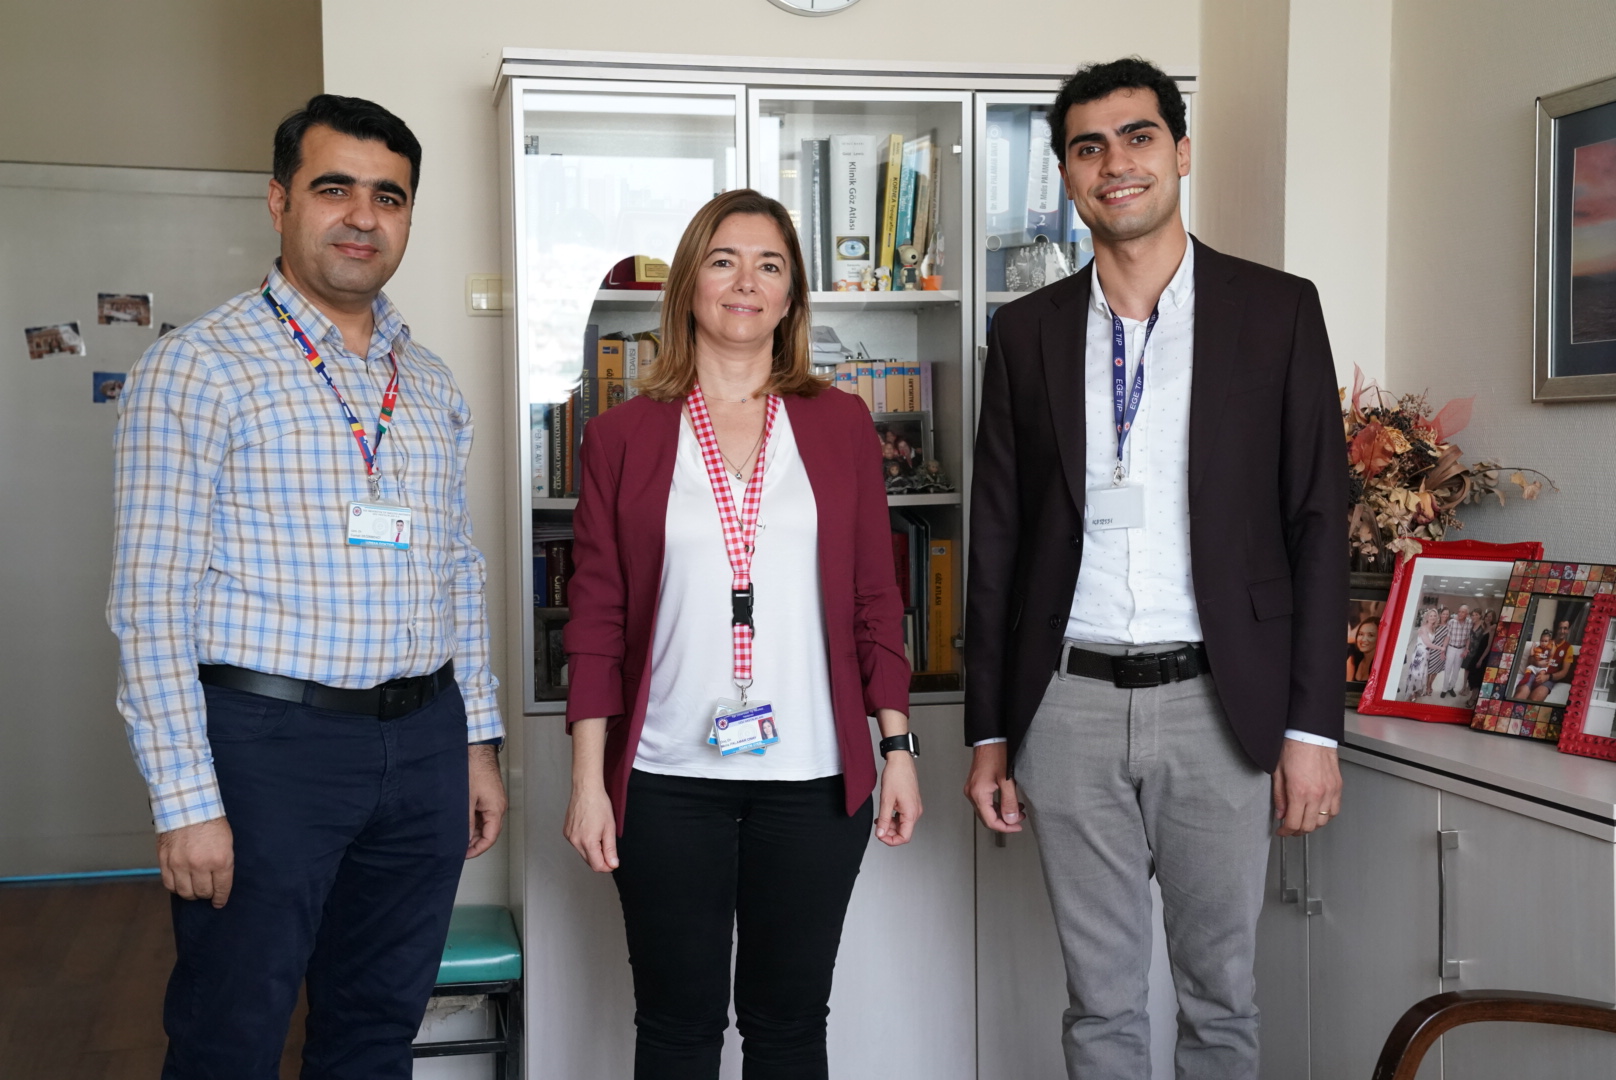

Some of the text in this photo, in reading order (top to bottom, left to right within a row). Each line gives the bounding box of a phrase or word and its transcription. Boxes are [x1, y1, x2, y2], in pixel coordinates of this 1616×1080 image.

[1041, 157, 1049, 184] PALAMAR
[848, 187, 857, 205] Göz
[891, 177, 899, 203] KORNEA
[848, 206, 857, 231] Atlası
[1039, 201, 1047, 210] Dr.
[1039, 215, 1046, 226] 2
[1114, 315, 1123, 346] EGE TIP
[628, 348, 636, 378] TEDAVİSİ
[1115, 379, 1124, 396] EGE
[1129, 376, 1142, 410] EGE TIP
[534, 429, 542, 465] PENTACAM
[554, 575, 565, 606] Current
